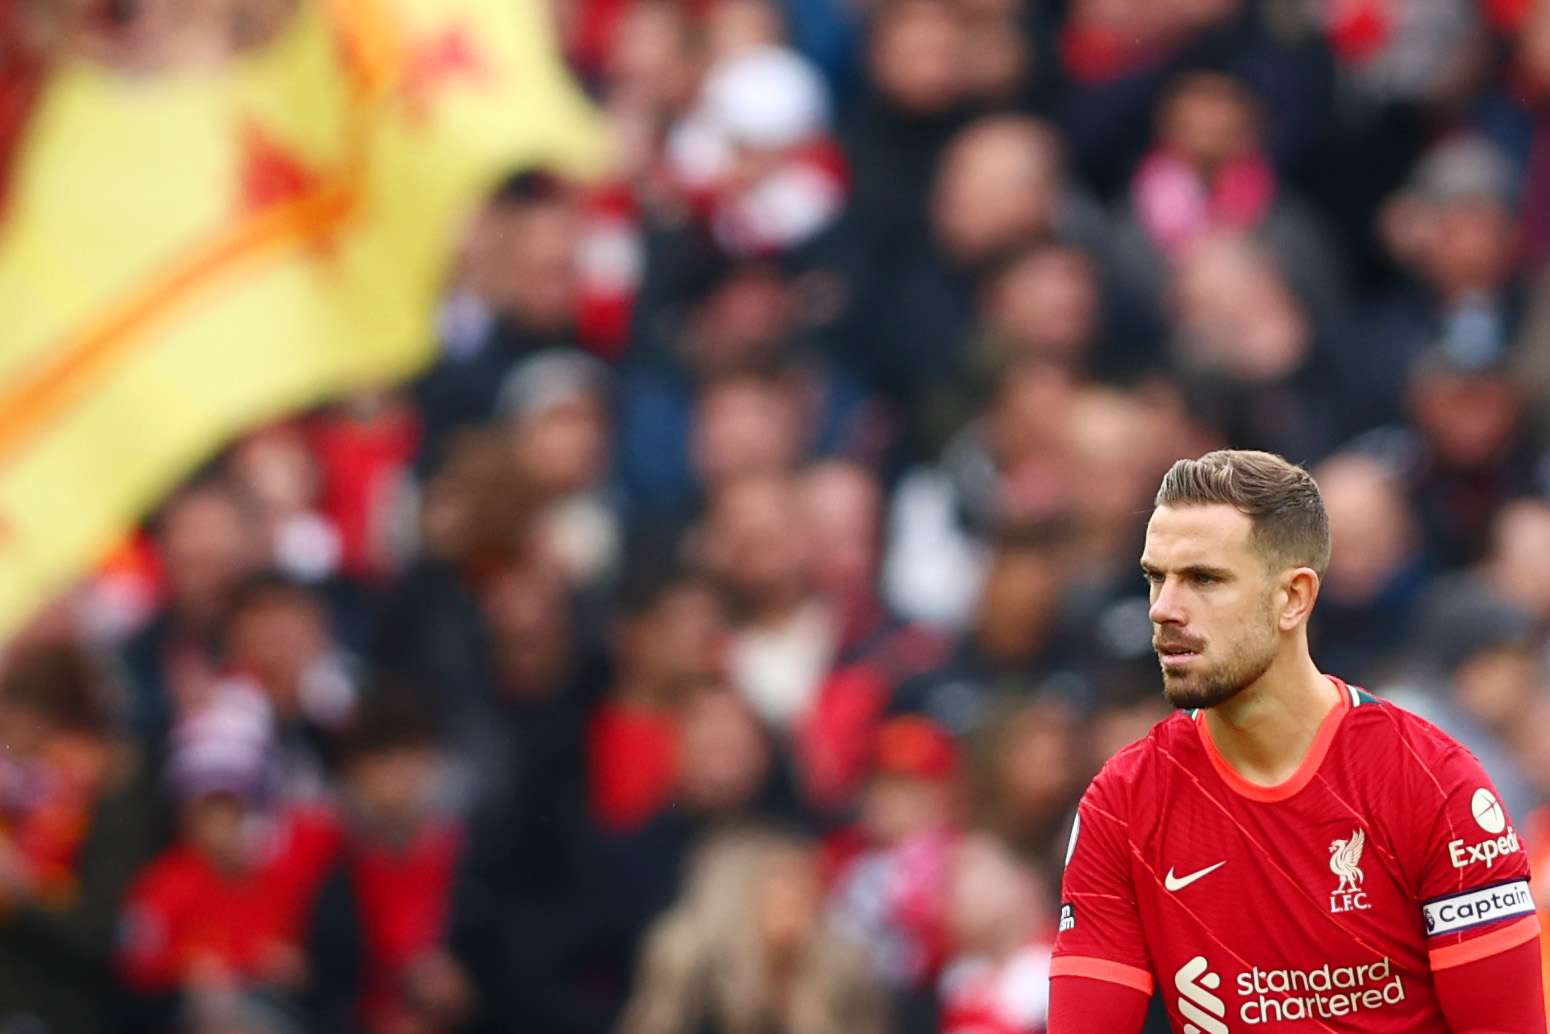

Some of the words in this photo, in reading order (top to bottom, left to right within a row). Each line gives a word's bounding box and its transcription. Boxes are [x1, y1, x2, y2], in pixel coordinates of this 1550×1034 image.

[1330, 892, 1372, 913] L.F.C.
[1439, 887, 1528, 922] Captain
[1236, 955, 1391, 996] standard
[1240, 975, 1406, 1024] chartered
